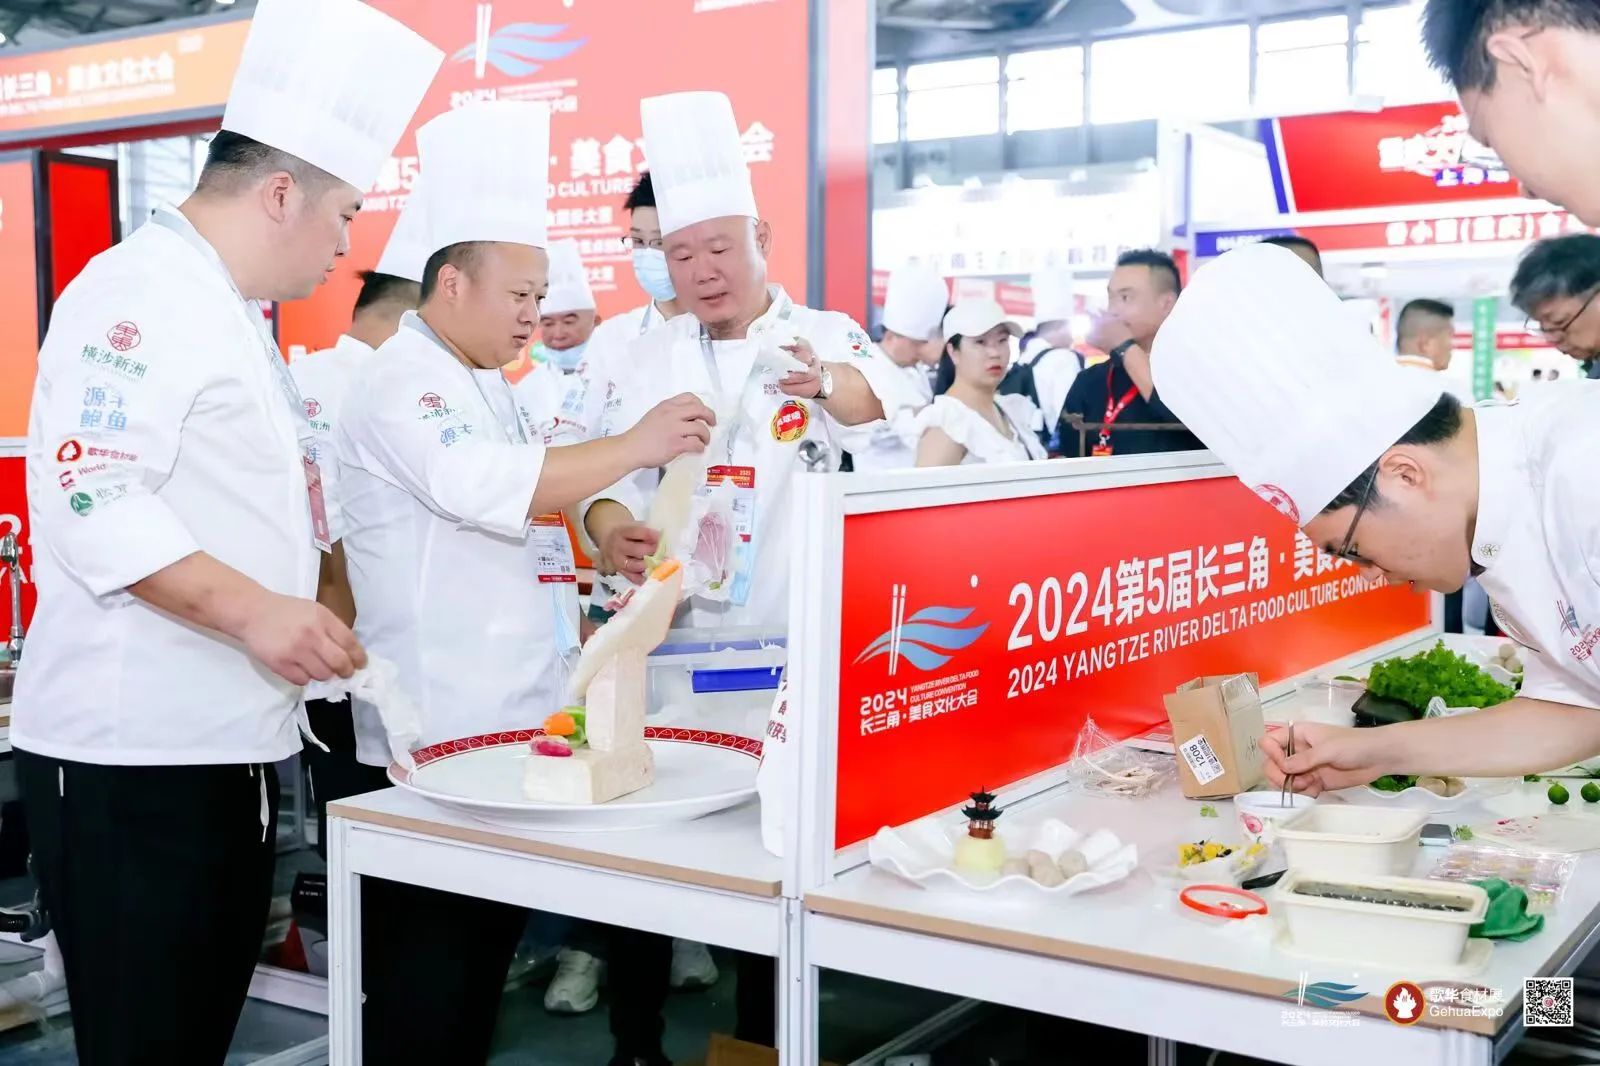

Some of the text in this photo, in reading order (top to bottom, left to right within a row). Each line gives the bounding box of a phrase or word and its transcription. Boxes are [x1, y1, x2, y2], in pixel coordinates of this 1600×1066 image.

[558, 177, 634, 198] CULTURE
[1007, 657, 1058, 699] 2024
[1063, 632, 1150, 681] YANGTZE
[1153, 618, 1199, 654] RIVER
[1202, 605, 1248, 640] DELTA
[1249, 595, 1285, 625] FOOD
[1286, 580, 1339, 614] CULTURE
[860, 687, 908, 716] 2024
[909, 682, 967, 704] CULTURE CONVENTION
[1189, 743, 1204, 767] 1208
